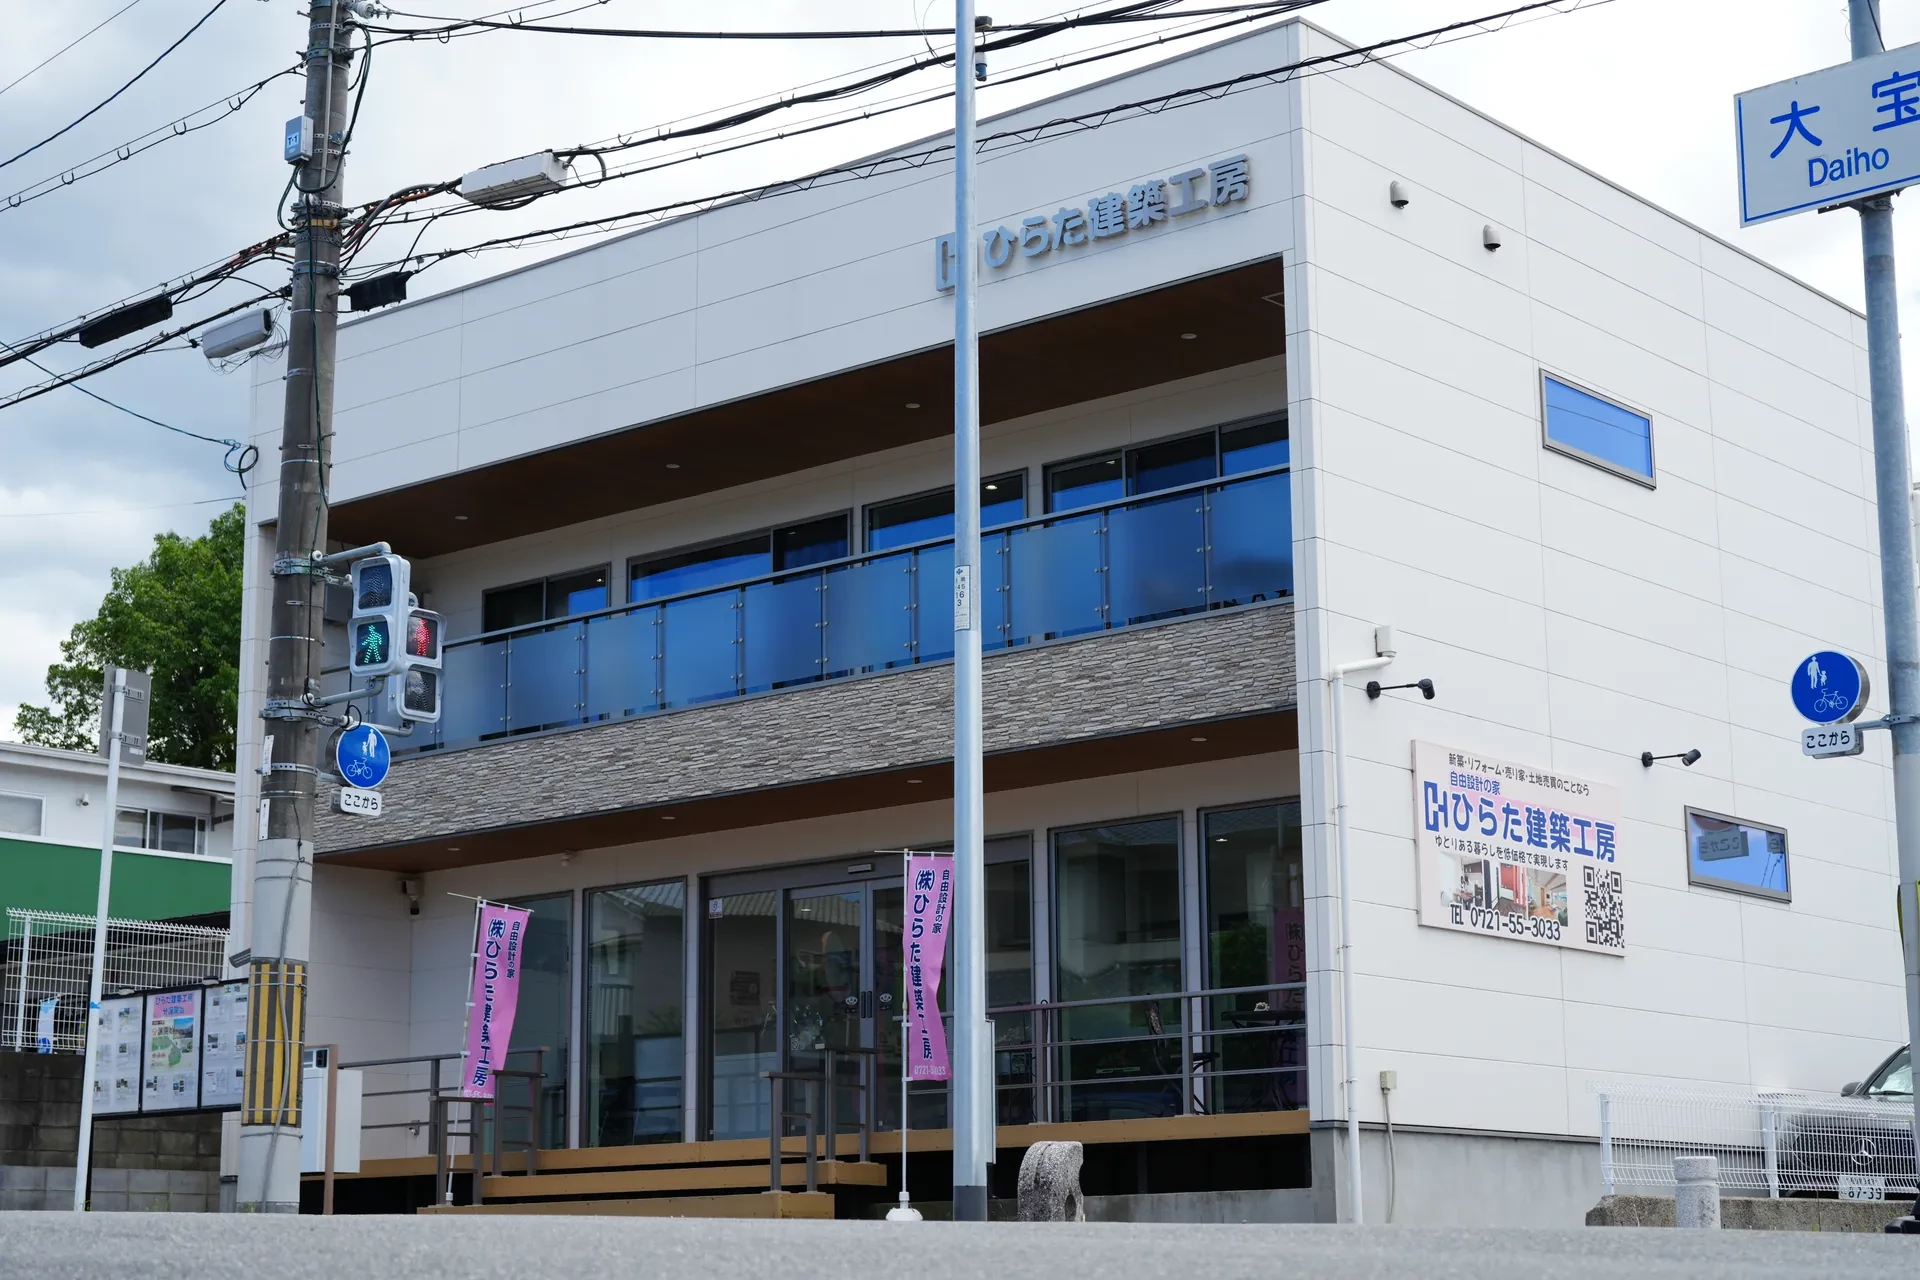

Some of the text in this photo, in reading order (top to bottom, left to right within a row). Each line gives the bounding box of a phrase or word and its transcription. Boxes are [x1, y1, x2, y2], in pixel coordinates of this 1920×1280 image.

[1770, 70, 1920, 159] 大宝
[1808, 147, 1889, 187] Daiho
[983, 153, 1249, 268] ひらた建築工房
[1806, 730, 1850, 748] ここから
[344, 793, 378, 810] ここから
[1450, 770, 1501, 796] 自由設計の家
[1451, 792, 1616, 863] ひらた建築工房
[1435, 835, 1568, 871] ゆとりある暮らしを低価格で実現します
[931, 869, 950, 934] 自由設計の家
[1450, 903, 1561, 941] TEL 0721-55-3033
